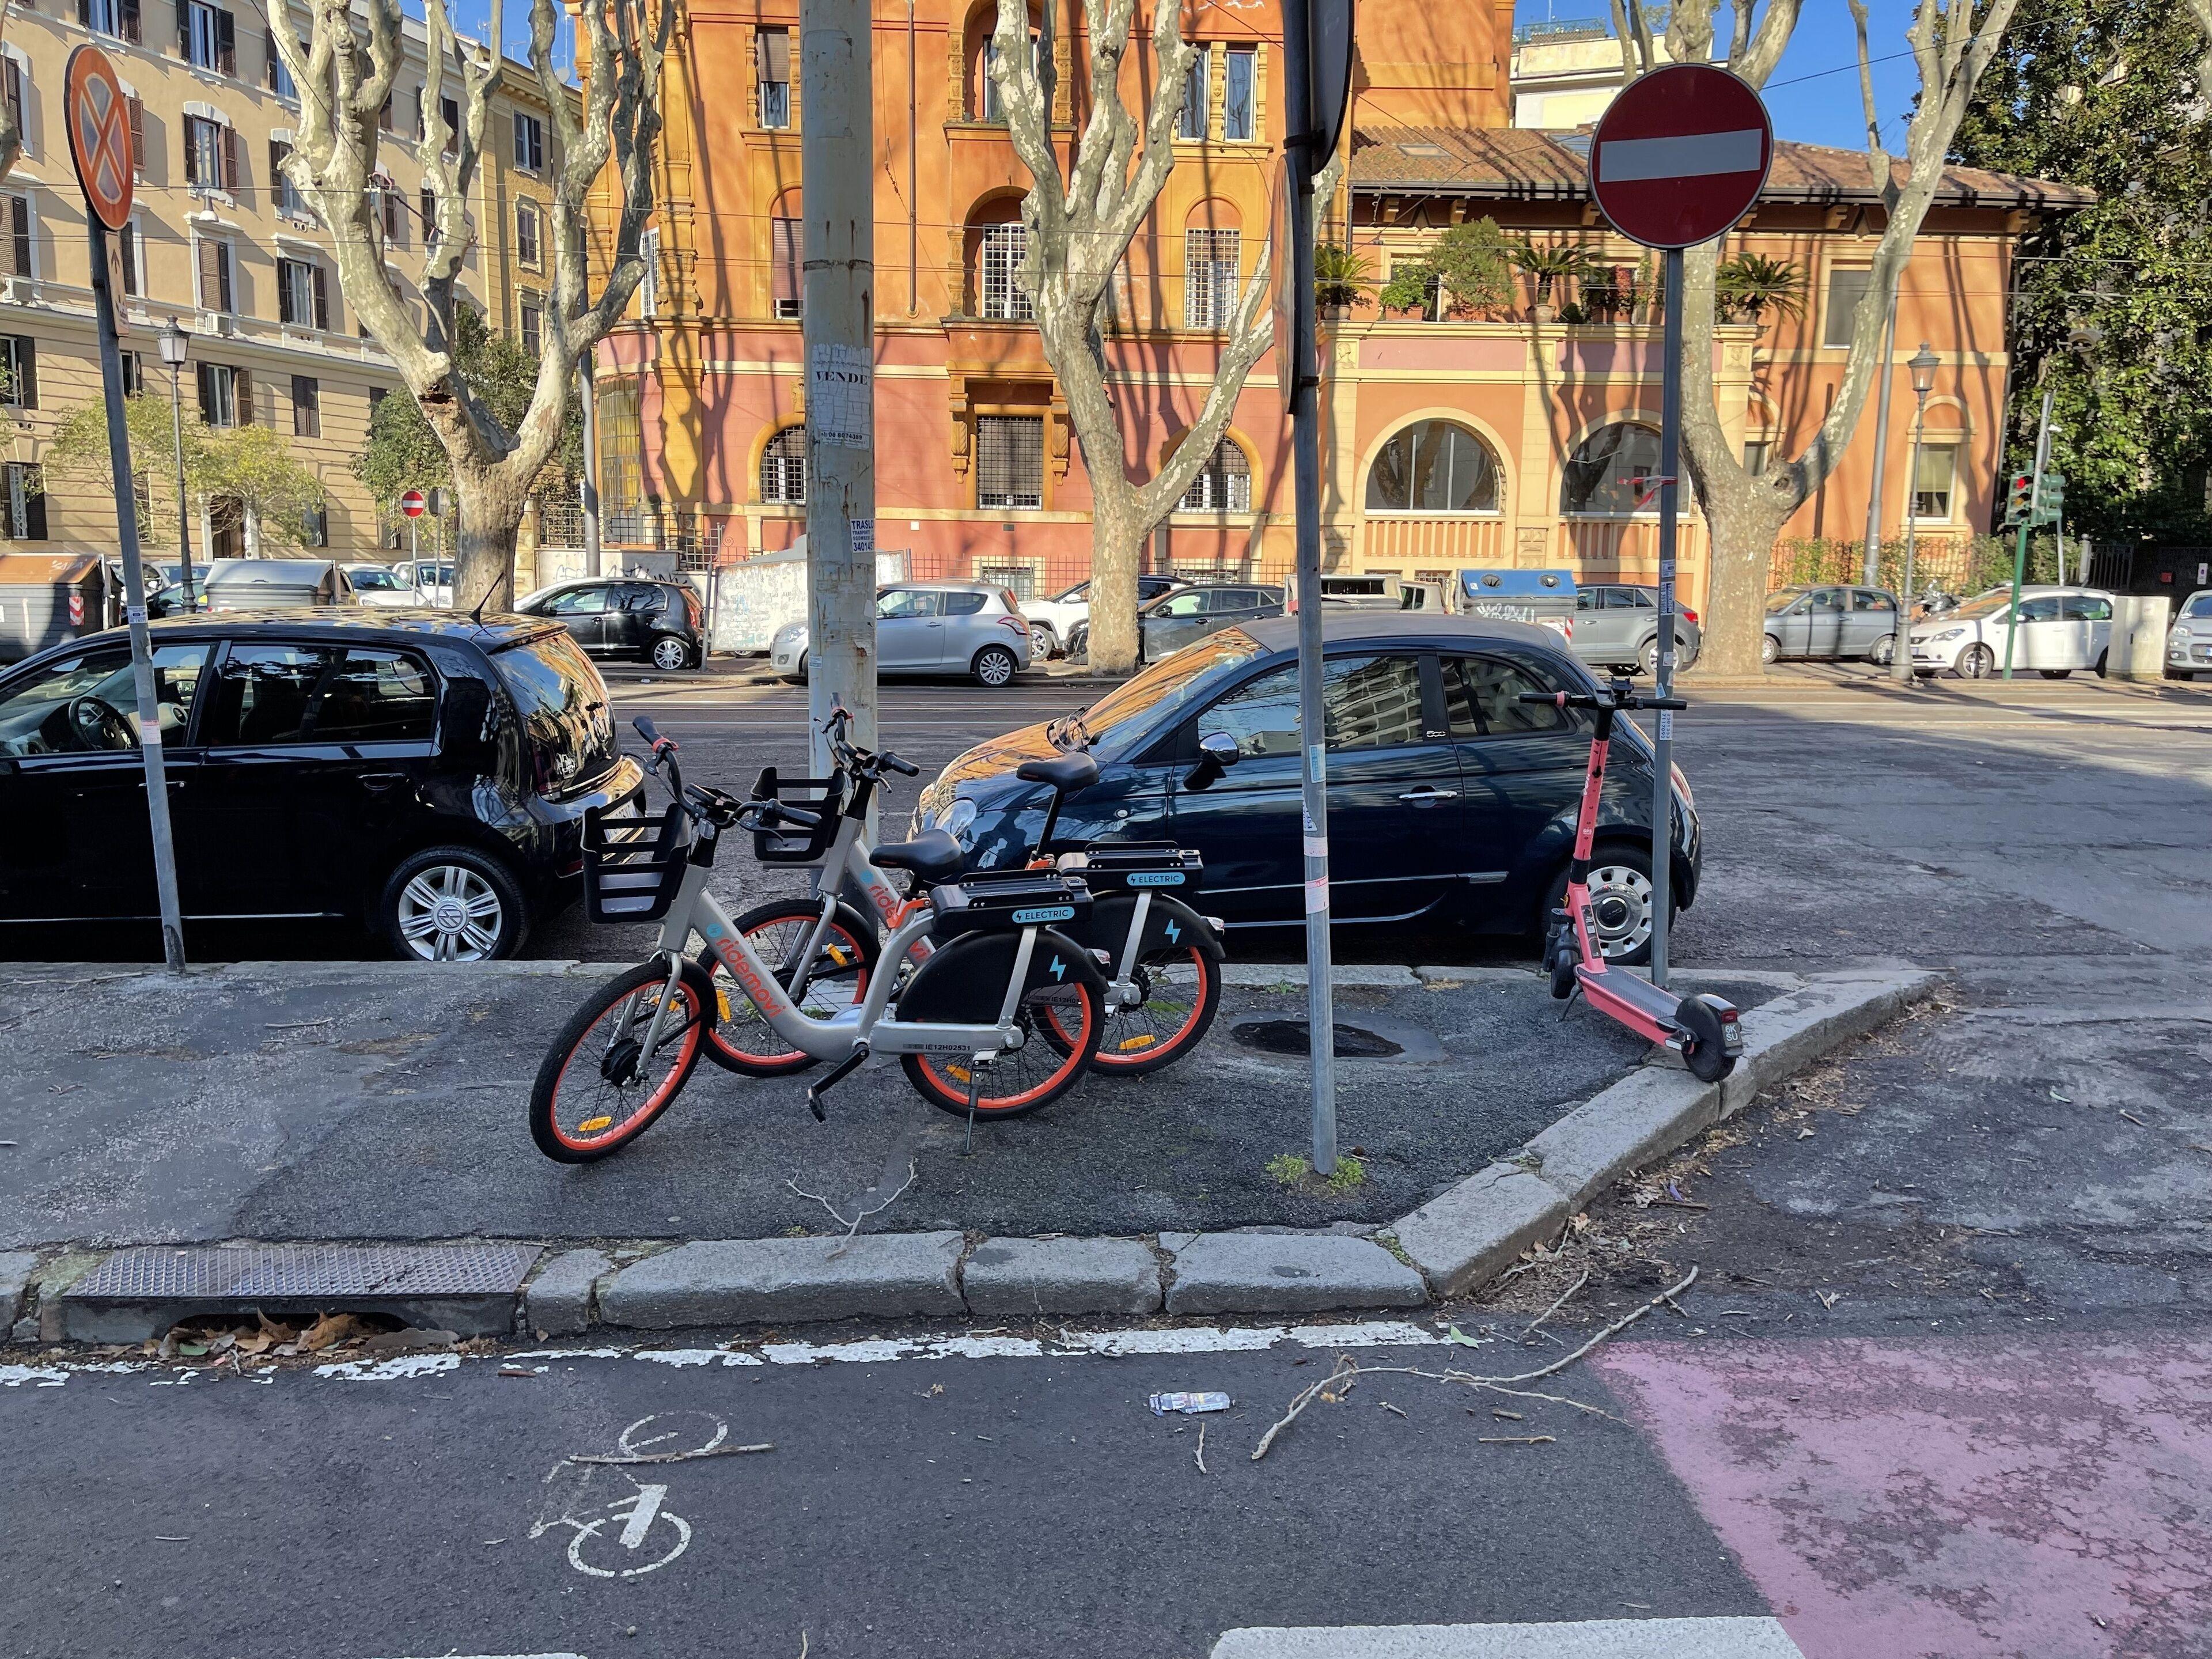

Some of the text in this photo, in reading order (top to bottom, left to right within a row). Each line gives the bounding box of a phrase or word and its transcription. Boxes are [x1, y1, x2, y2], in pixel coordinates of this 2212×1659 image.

[816, 371, 868, 385] VENDE
[1139, 875, 1180, 883] ELECTRIC
[1025, 910, 1069, 920] ELECTRIC
[715, 938, 786, 1018] ridemovi
[1725, 1025, 1736, 1033] 6K
[1726, 1032, 1738, 1041] SU
